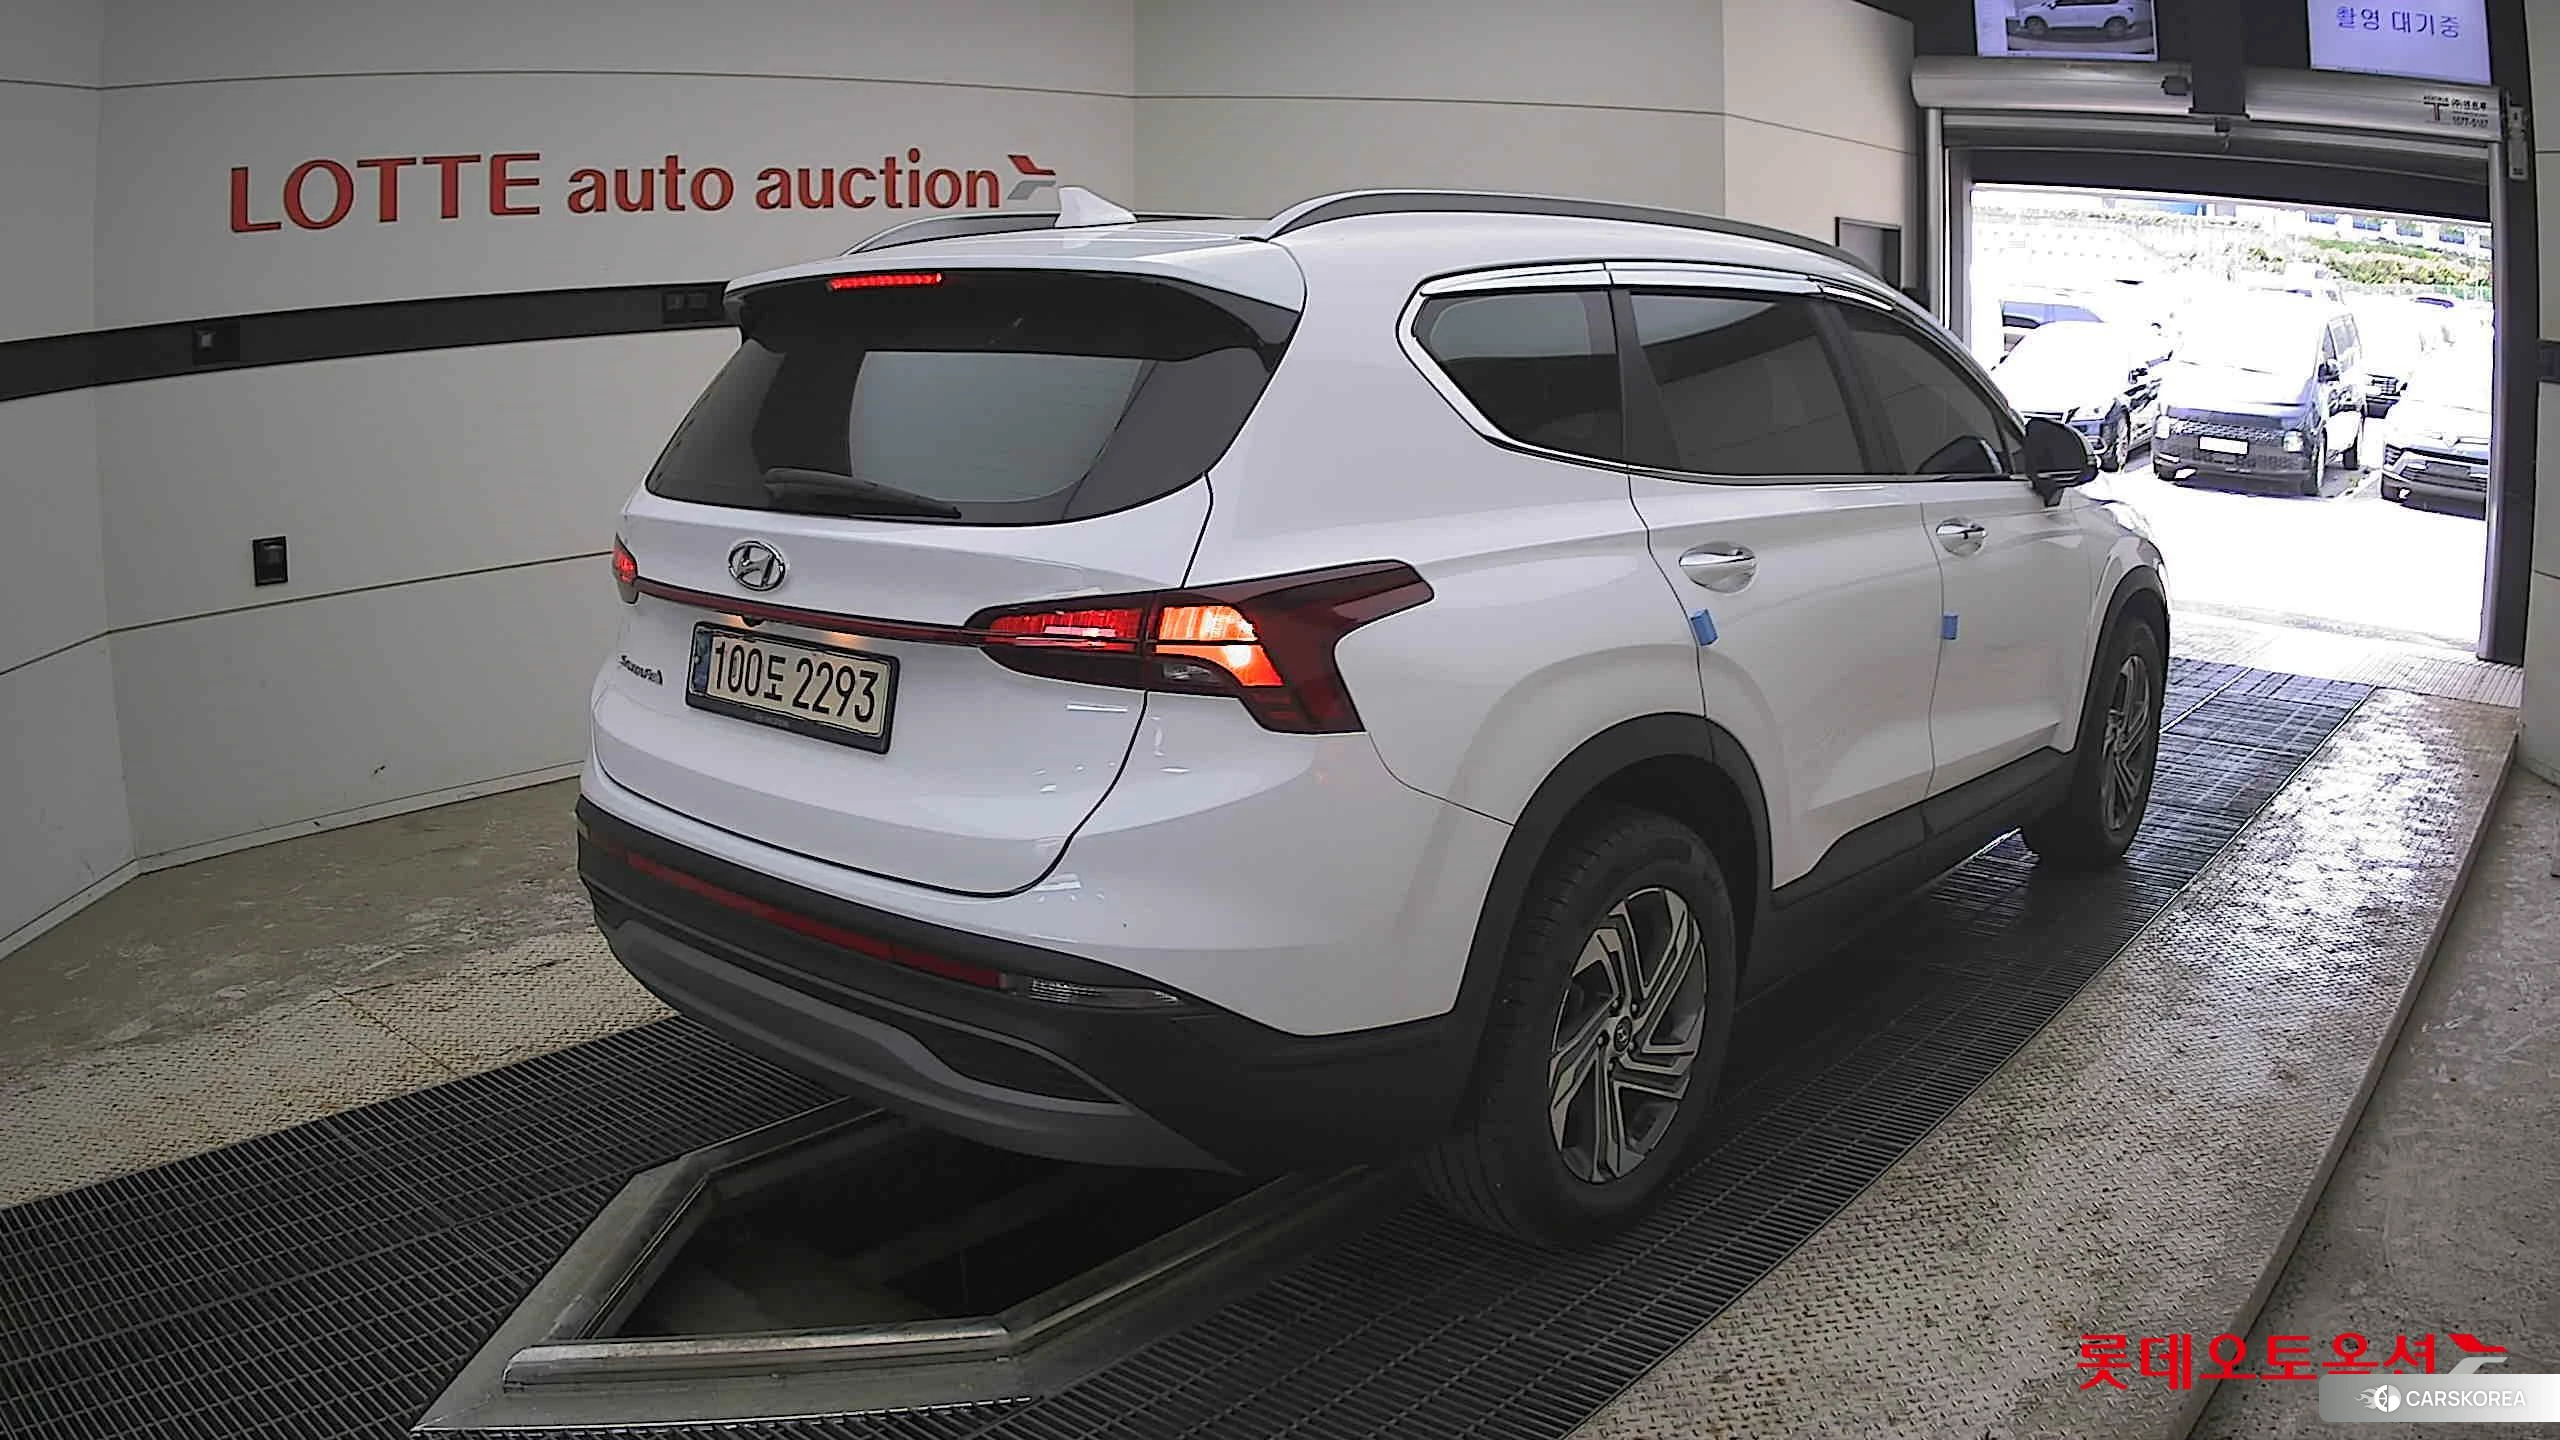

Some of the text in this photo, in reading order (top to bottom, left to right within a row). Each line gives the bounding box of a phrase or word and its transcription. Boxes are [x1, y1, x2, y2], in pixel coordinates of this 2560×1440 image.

[2336, 5, 2460, 39] 촬영 대기중
[230, 148, 1001, 233] LOTTE auto auction
